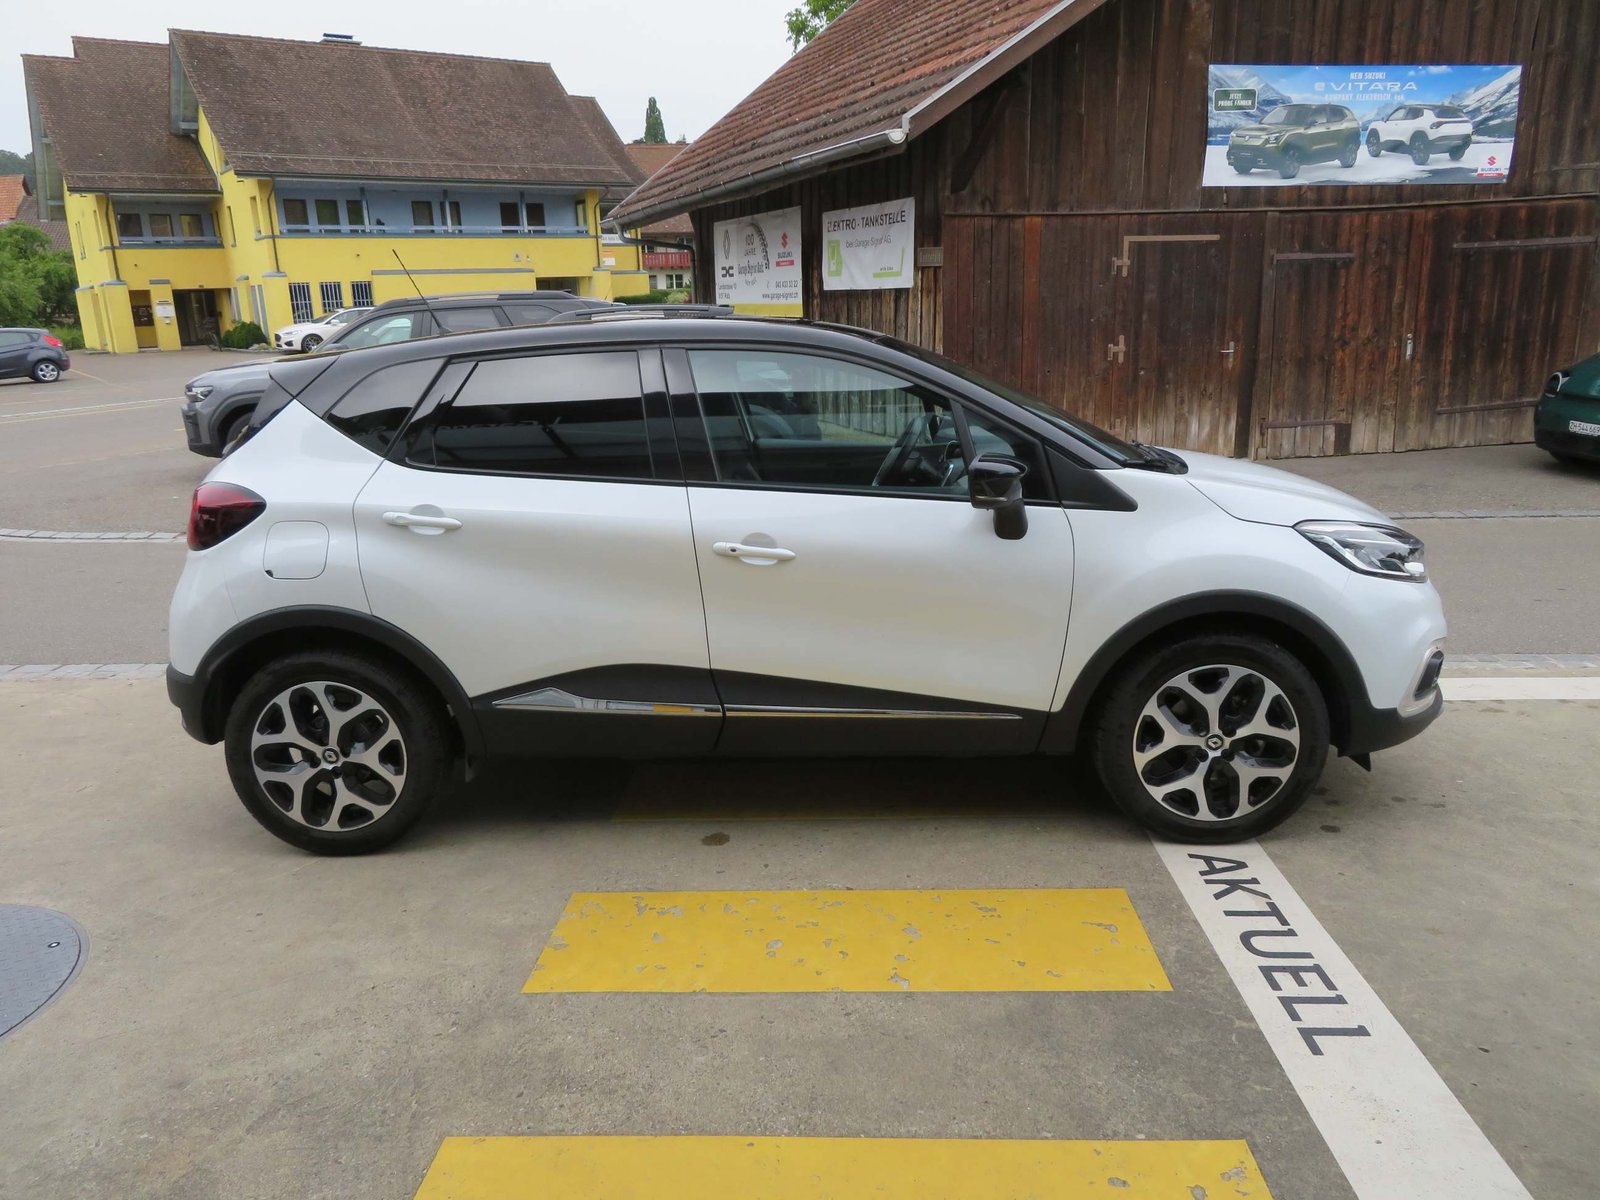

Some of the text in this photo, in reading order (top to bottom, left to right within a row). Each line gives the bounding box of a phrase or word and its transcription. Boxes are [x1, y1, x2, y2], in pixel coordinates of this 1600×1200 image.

[1330, 81, 1418, 91] VITARA
[861, 210, 906, 229] TANKSTELLE
[777, 251, 793, 259] SUZUKI
[1187, 853, 1372, 1056] AKTUELL
